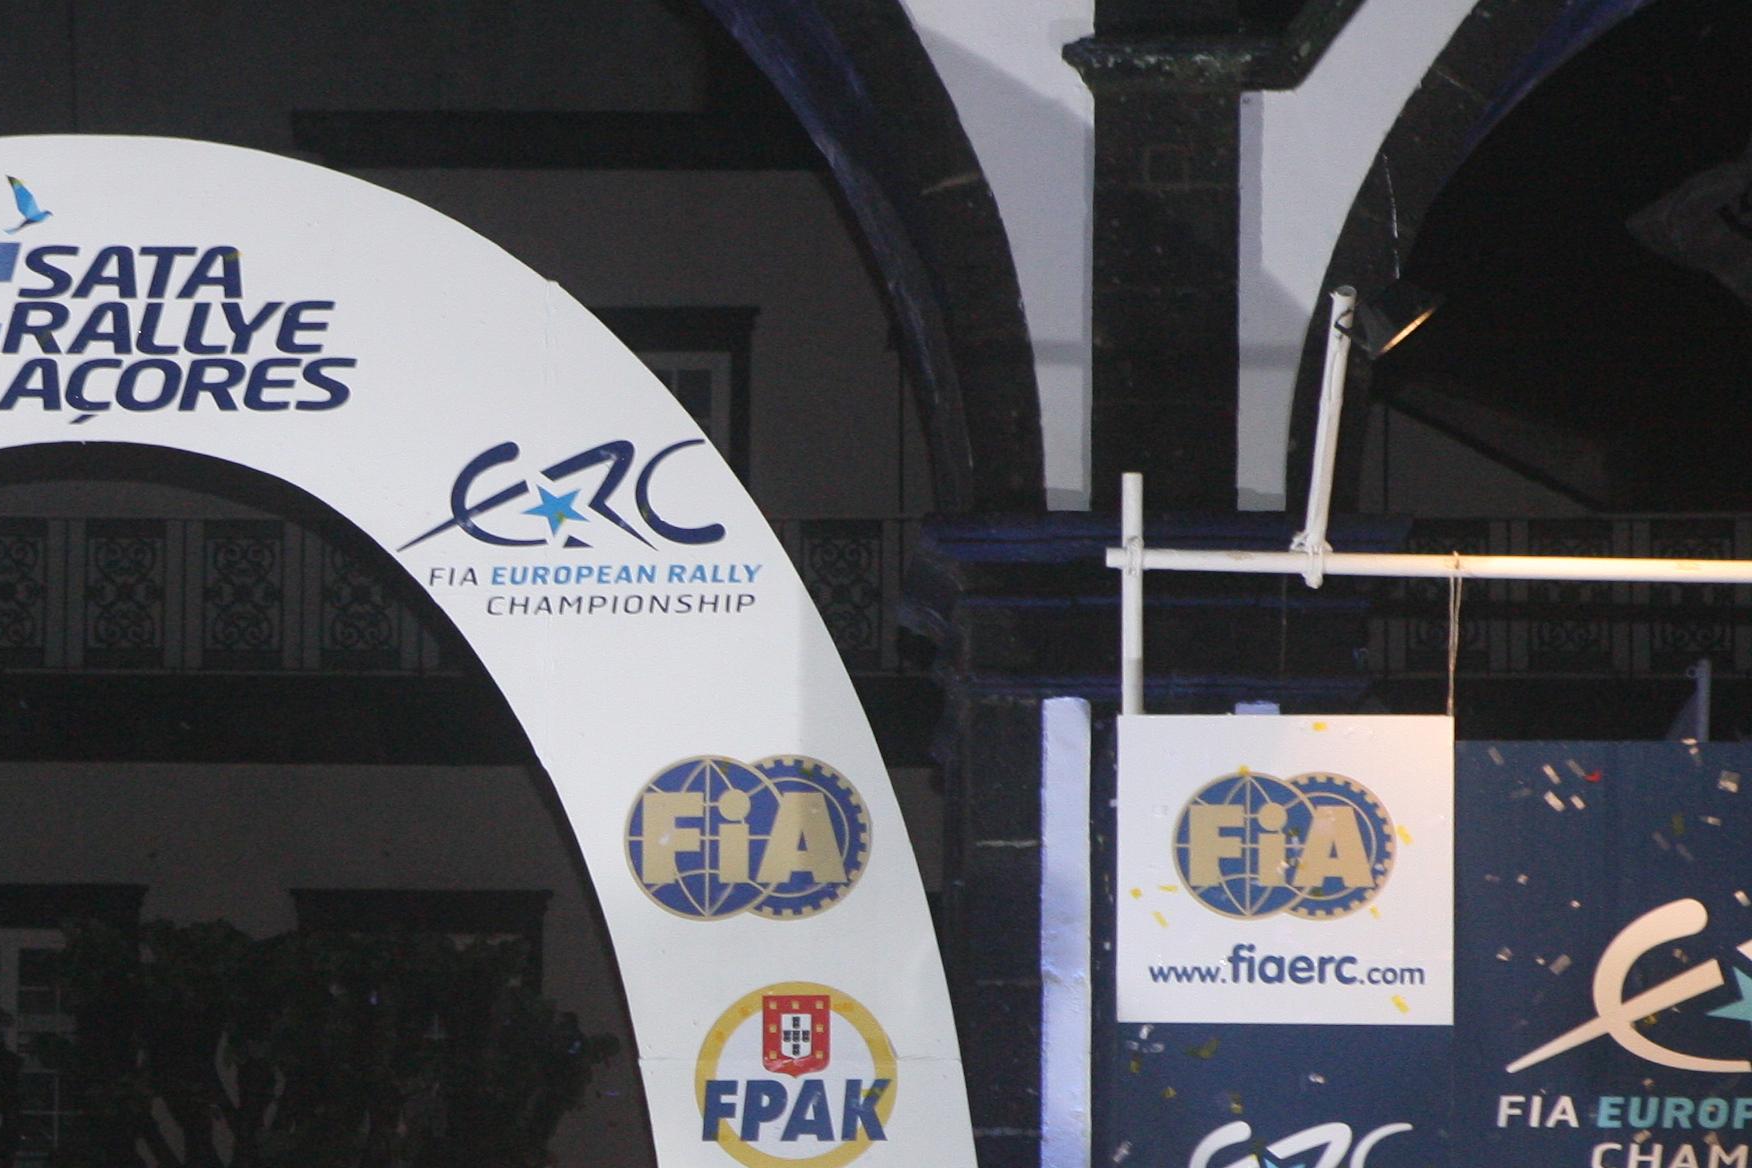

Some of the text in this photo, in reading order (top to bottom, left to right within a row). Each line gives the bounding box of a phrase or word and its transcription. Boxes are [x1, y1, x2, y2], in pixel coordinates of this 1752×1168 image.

[17, 245, 244, 299] SATA
[1, 300, 336, 355] RALLYE
[429, 563, 762, 586] FIA EUROPEAN RALLY
[486, 593, 756, 616] CHAMPIONSHIP
[1149, 944, 1426, 986] www.fiaerc.com
[702, 1078, 891, 1142] FPAK
[1496, 1094, 1580, 1129] FIA
